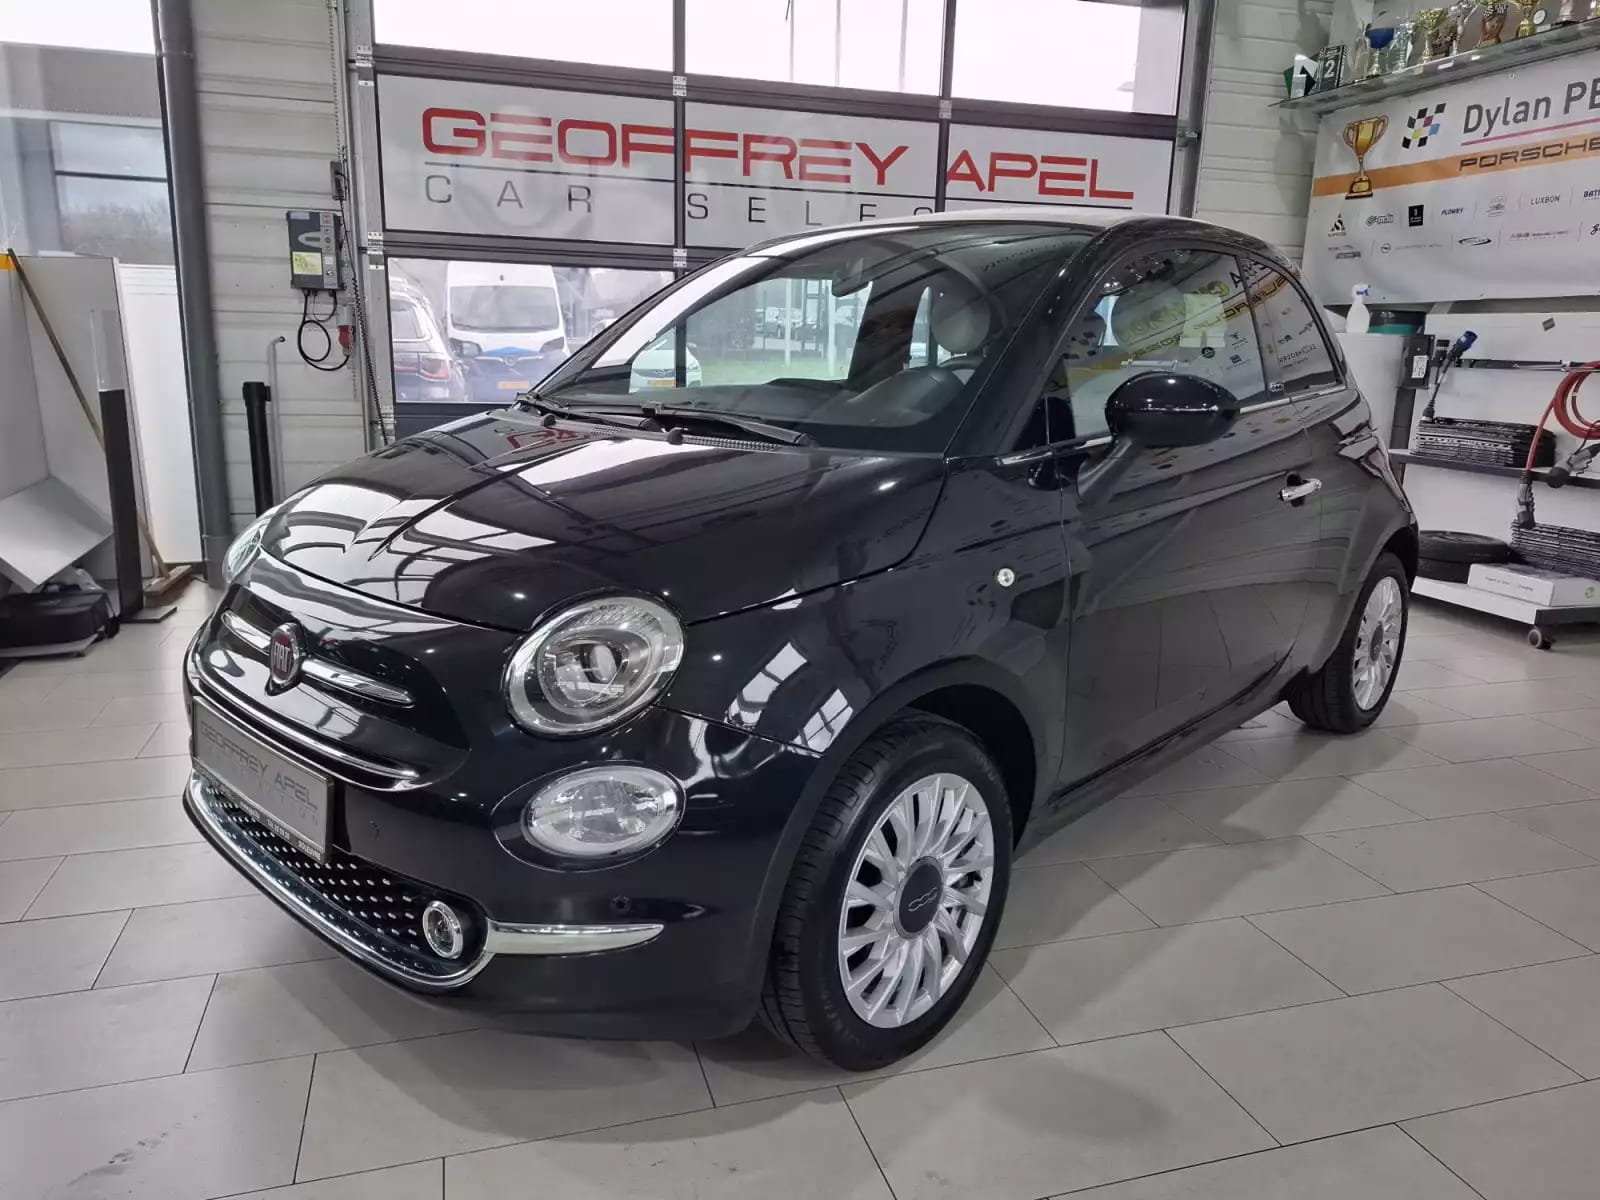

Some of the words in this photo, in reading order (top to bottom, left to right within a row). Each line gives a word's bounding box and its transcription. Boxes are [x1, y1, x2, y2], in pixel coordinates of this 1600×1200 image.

[1324, 60, 1335, 78] 2
[1463, 96, 1551, 137] Dylan
[422, 107, 910, 186] GEOFFREY
[946, 149, 1134, 200] APEL
[1459, 138, 1600, 171] PORSCHE
[425, 174, 592, 213] CAR
[1531, 194, 1560, 205] LUXBON
[274, 641, 291, 673] FIAT
[200, 721, 268, 776] GEOFFREY
[274, 772, 318, 810] APEL
